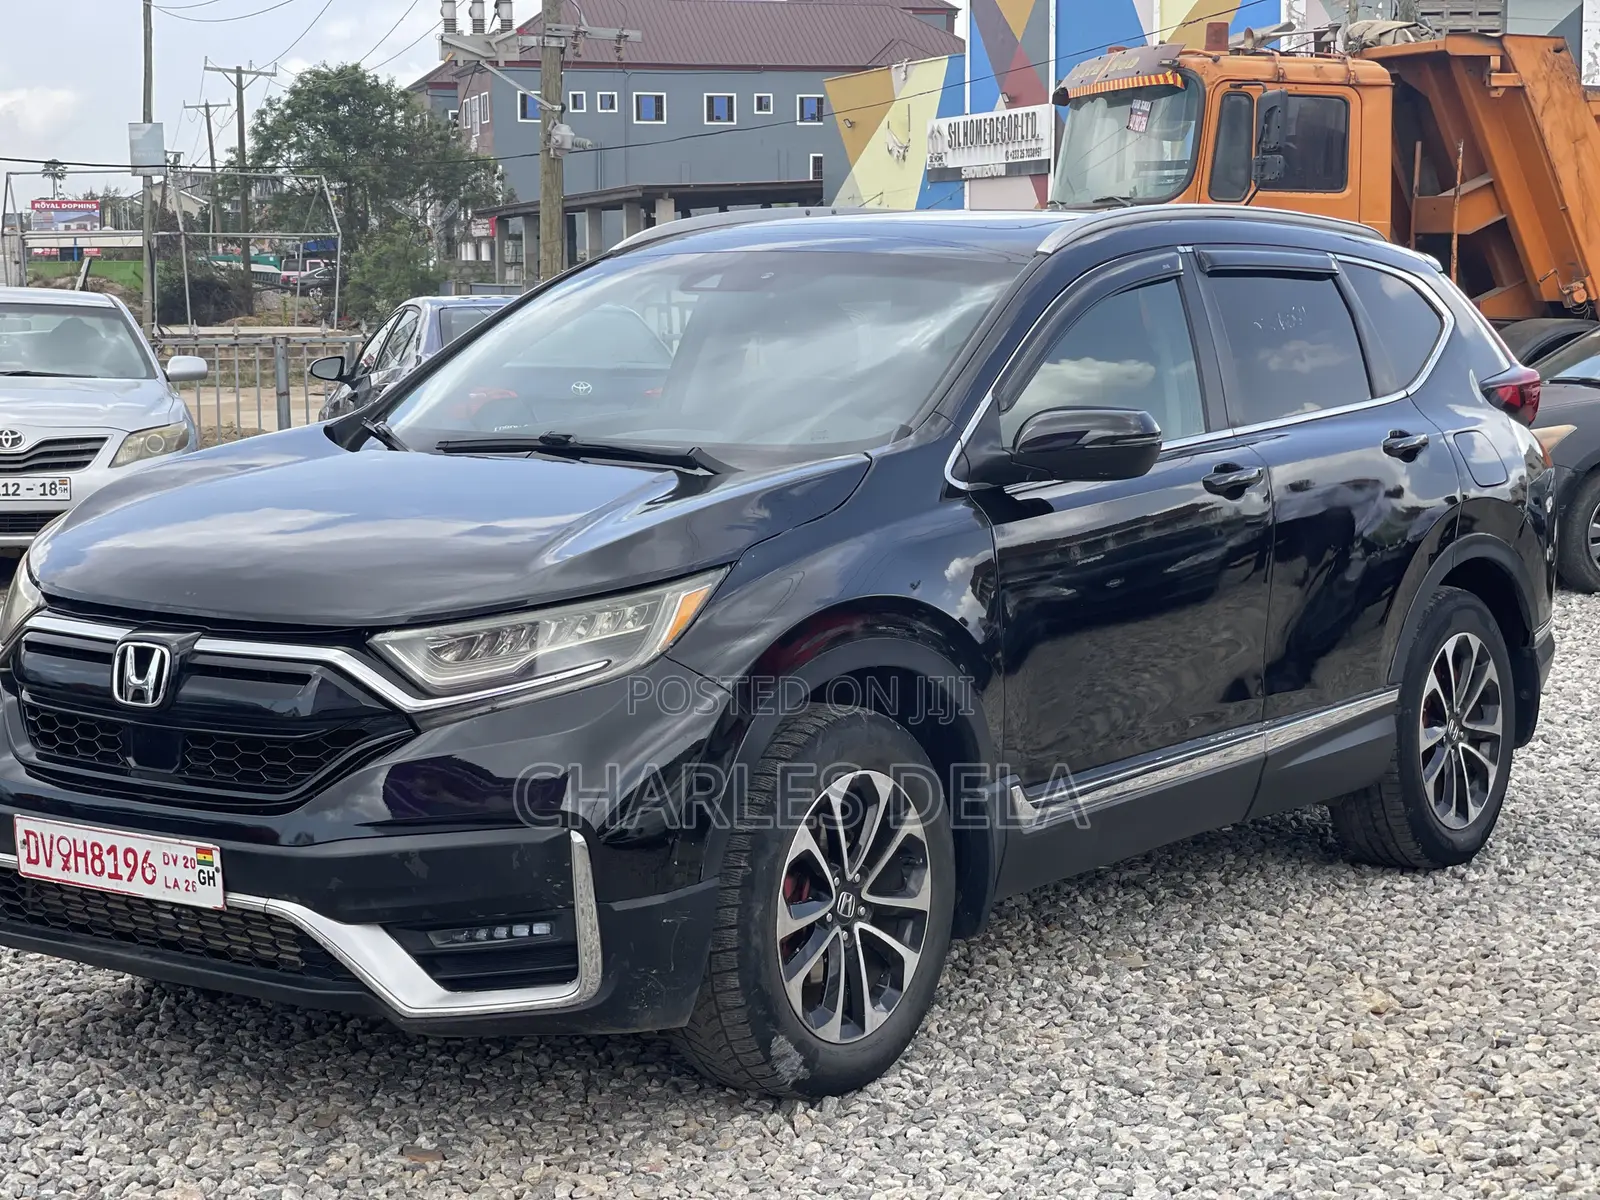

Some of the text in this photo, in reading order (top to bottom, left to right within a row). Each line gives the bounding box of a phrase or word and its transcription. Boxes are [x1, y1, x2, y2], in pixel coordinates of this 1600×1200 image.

[947, 122, 962, 149] SIL
[963, 118, 988, 146] HOME
[989, 113, 1019, 144] DECOR
[0, 482, 21, 497] 12
[39, 482, 58, 497] 18
[162, 852, 196, 870] DV 20
[164, 875, 181, 891] LA
[197, 868, 216, 887] GH
